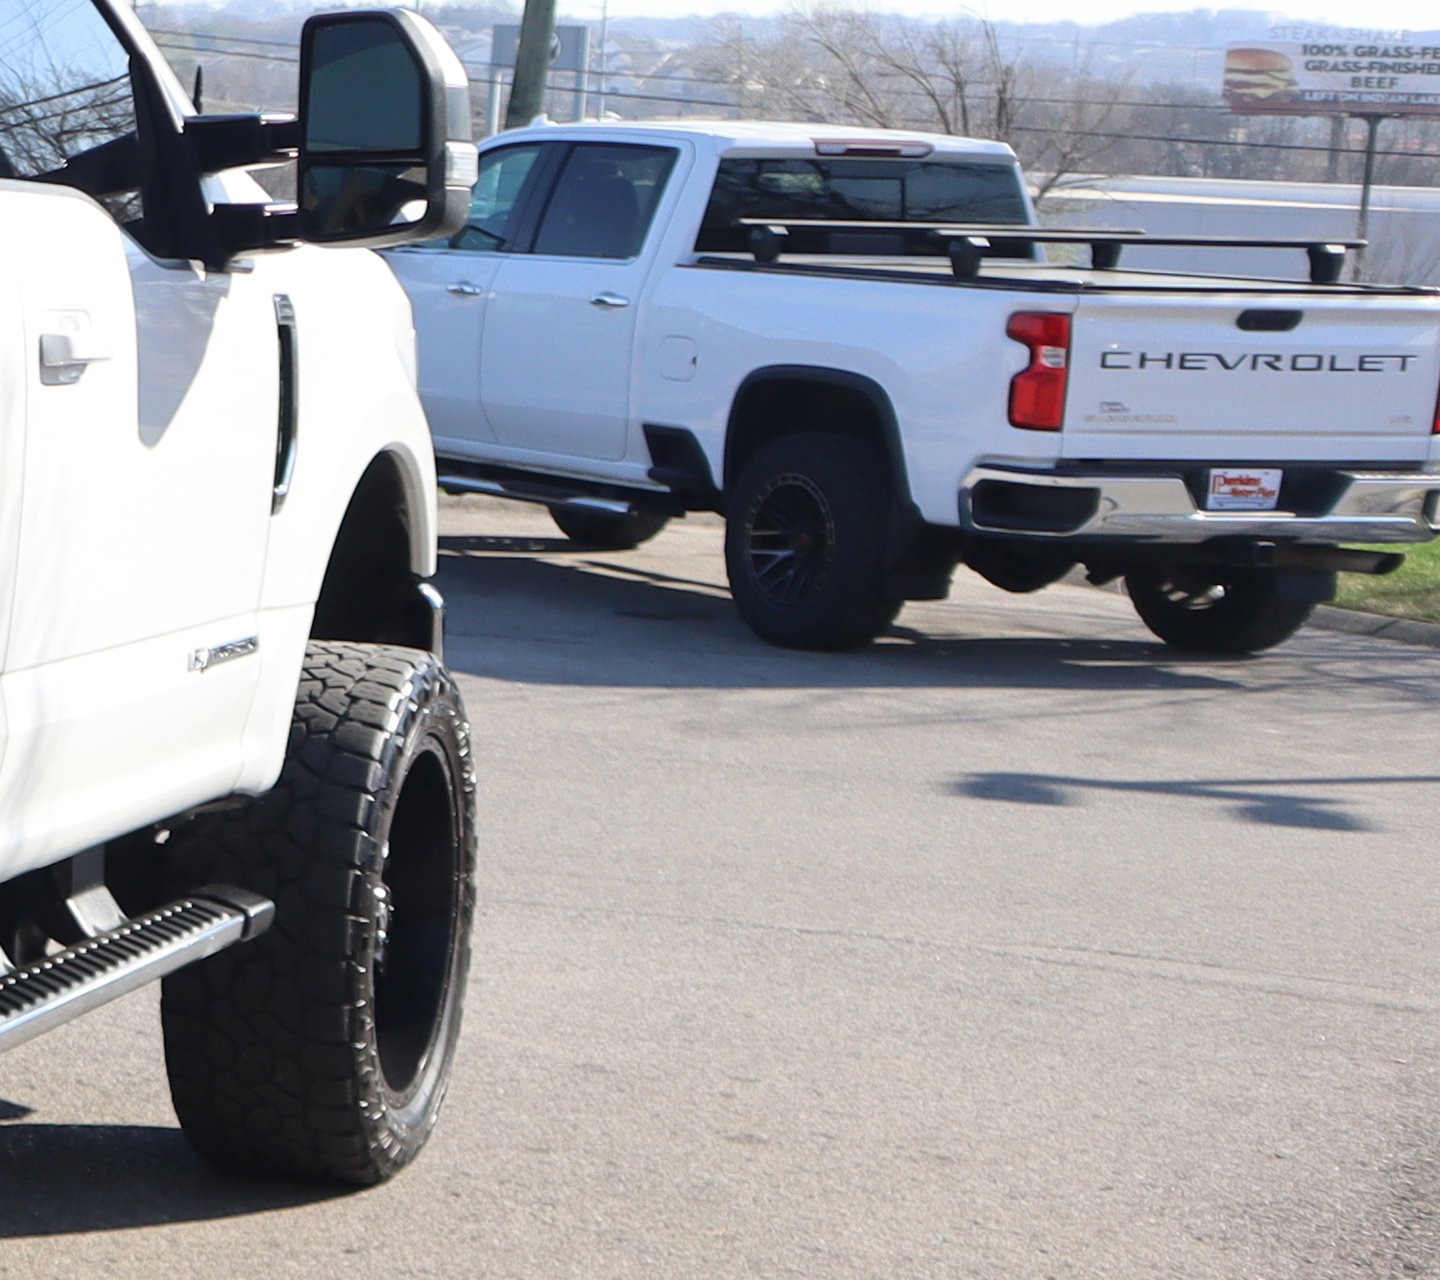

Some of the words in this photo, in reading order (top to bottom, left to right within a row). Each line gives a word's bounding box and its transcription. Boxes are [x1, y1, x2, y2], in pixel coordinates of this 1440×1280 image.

[1302, 44, 1348, 58] 100%
[1350, 76, 1401, 89] BEEF
[1099, 351, 1419, 372] CHEVROLET
